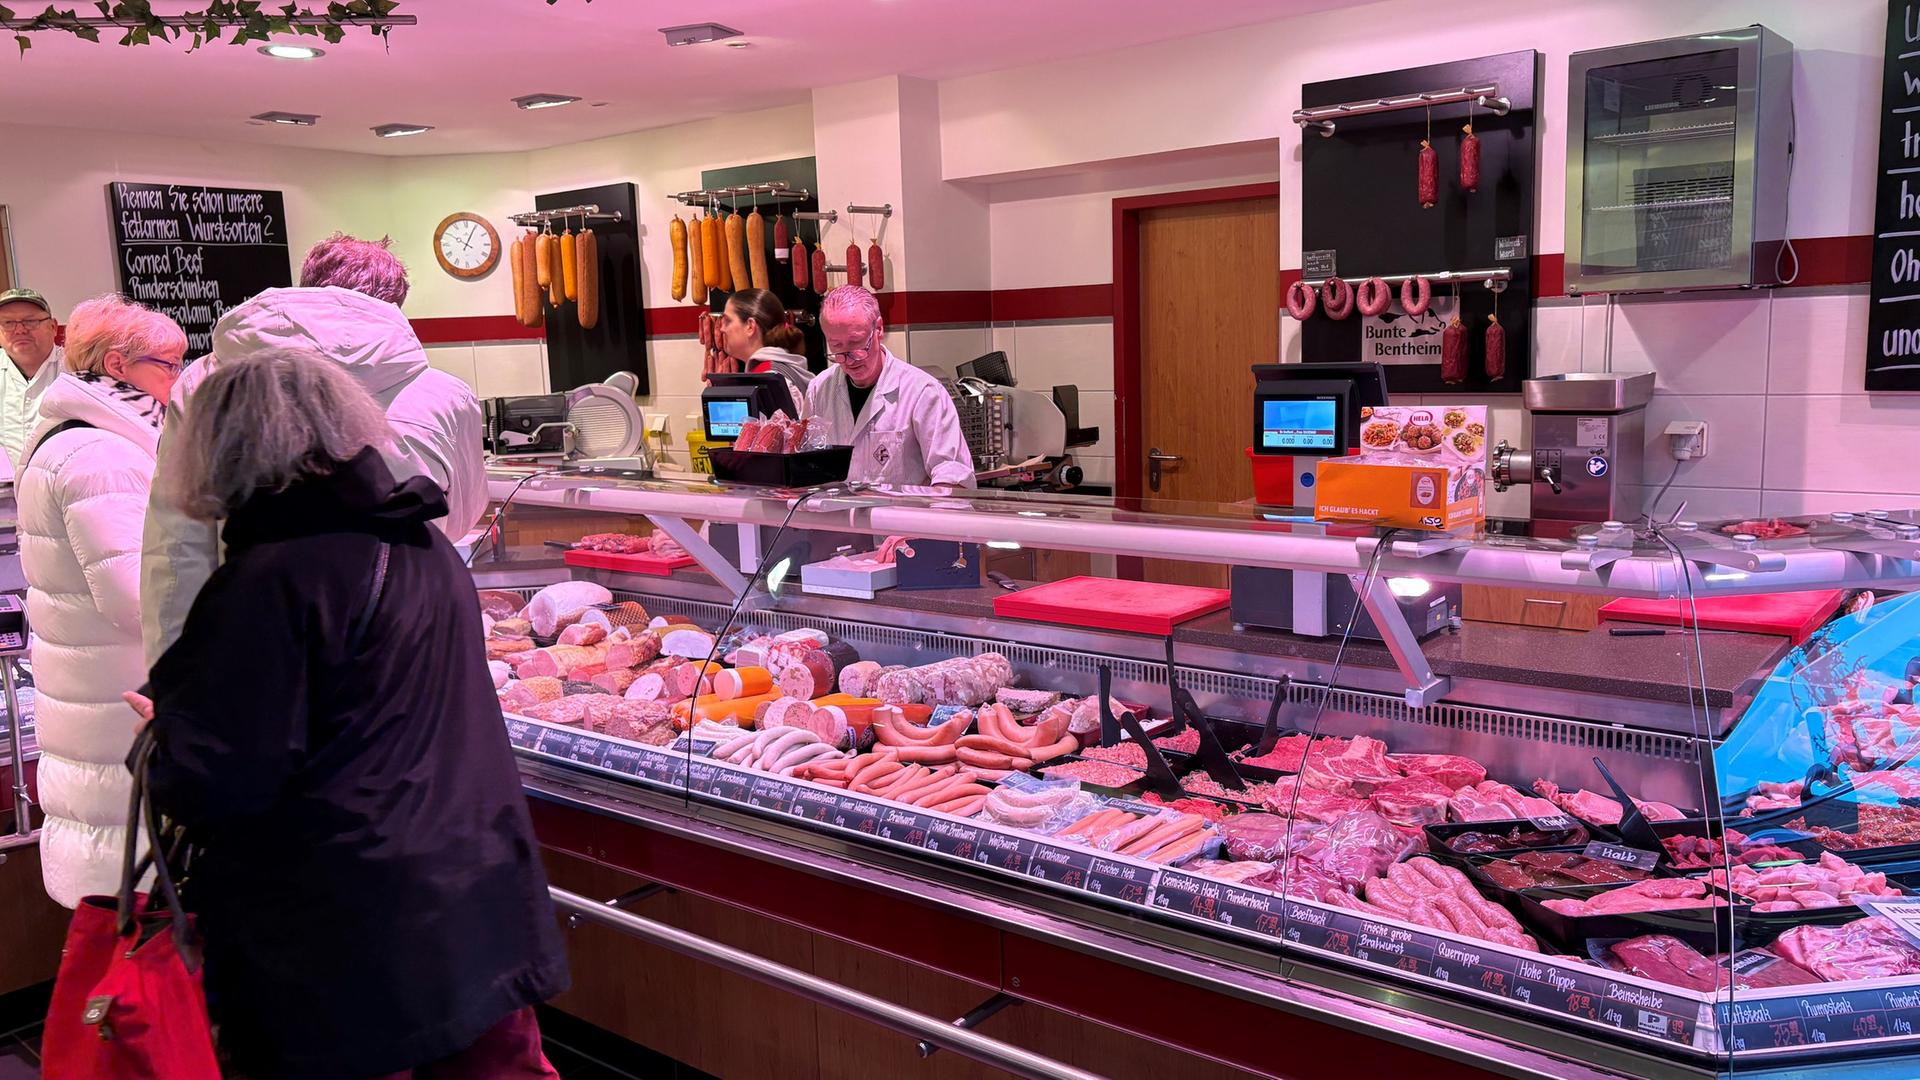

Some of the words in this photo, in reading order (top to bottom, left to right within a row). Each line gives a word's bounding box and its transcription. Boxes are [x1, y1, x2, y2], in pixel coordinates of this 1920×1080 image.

[117, 183, 163, 211] Kennen
[168, 184, 189, 212] Sie
[192, 187, 225, 213] schon
[227, 192, 263, 213] unsere
[121, 211, 180, 239] fettarmen
[126, 246, 171, 275] Corned
[173, 246, 204, 276] Beef
[128, 275, 219, 300] Rinderschinken
[1366, 325, 1407, 339] Bunte
[1375, 342, 1442, 356] Bentheim
[1359, 508, 1379, 516] HACKT
[988, 834, 1020, 851] Weißwurst
[1601, 847, 1637, 862] Kalb
[1096, 859, 1119, 876] Frisches
[1162, 872, 1199, 894] Gemischtes
[1200, 883, 1220, 899] Hack
[1226, 889, 1270, 911] Rinderhack
[1290, 905, 1327, 926] Beefhack
[1363, 920, 1388, 937] Frische
[1391, 929, 1412, 942] grobe
[1358, 934, 1404, 954] Bratwurst
[1438, 942, 1480, 967] Querrippe
[1434, 966, 1449, 982] 1kg
[1519, 961, 1542, 980] Hohe
[1547, 968, 1576, 992] Rippe
[1515, 985, 1531, 1004] 1kg
[1607, 983, 1663, 1009] Beinscheibe
[1603, 1008, 1622, 1028] 1kg
[1801, 997, 1854, 1022] Rumpsteak
[1811, 1028, 1826, 1043] 1kg
[1894, 1017, 1911, 1035] 1kg
